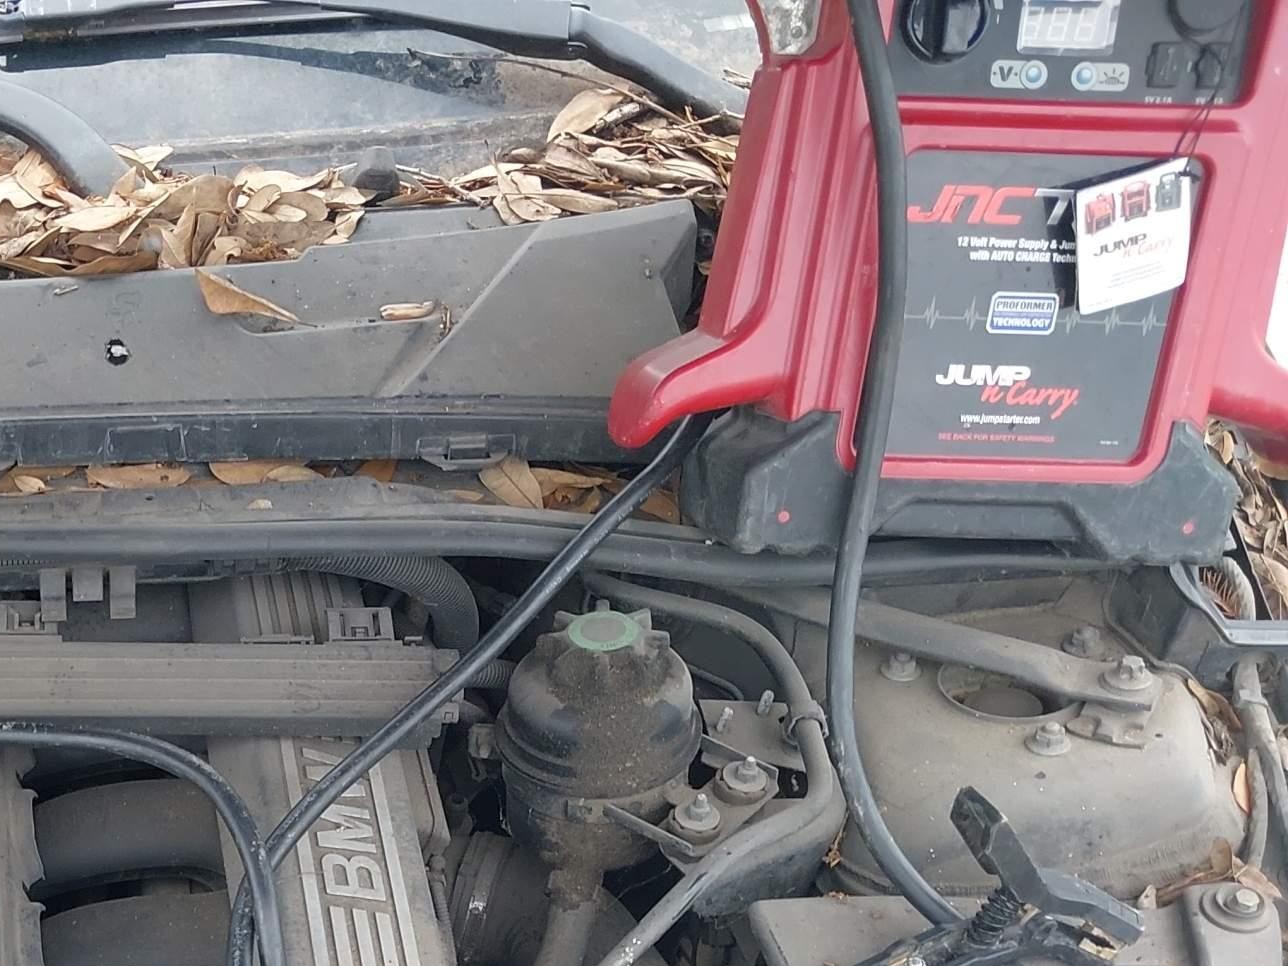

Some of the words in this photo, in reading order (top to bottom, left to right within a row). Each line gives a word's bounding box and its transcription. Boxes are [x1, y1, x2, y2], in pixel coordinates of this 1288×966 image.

[906, 184, 1076, 225] JNC7
[957, 236, 969, 247] 12
[970, 236, 988, 248] Volt
[989, 236, 1017, 249] Power
[1018, 237, 1049, 251] Supply
[1050, 239, 1057, 250] &
[1092, 232, 1148, 257] JUMP
[969, 249, 990, 261] with
[990, 250, 1015, 262] AUTO
[1015, 251, 1051, 263] CHARGE
[995, 300, 1054, 312] PROFORMER
[992, 317, 1051, 328] TECHNOLOGY
[935, 364, 1032, 386] JUMP
[1006, 381, 1079, 420] Carry
